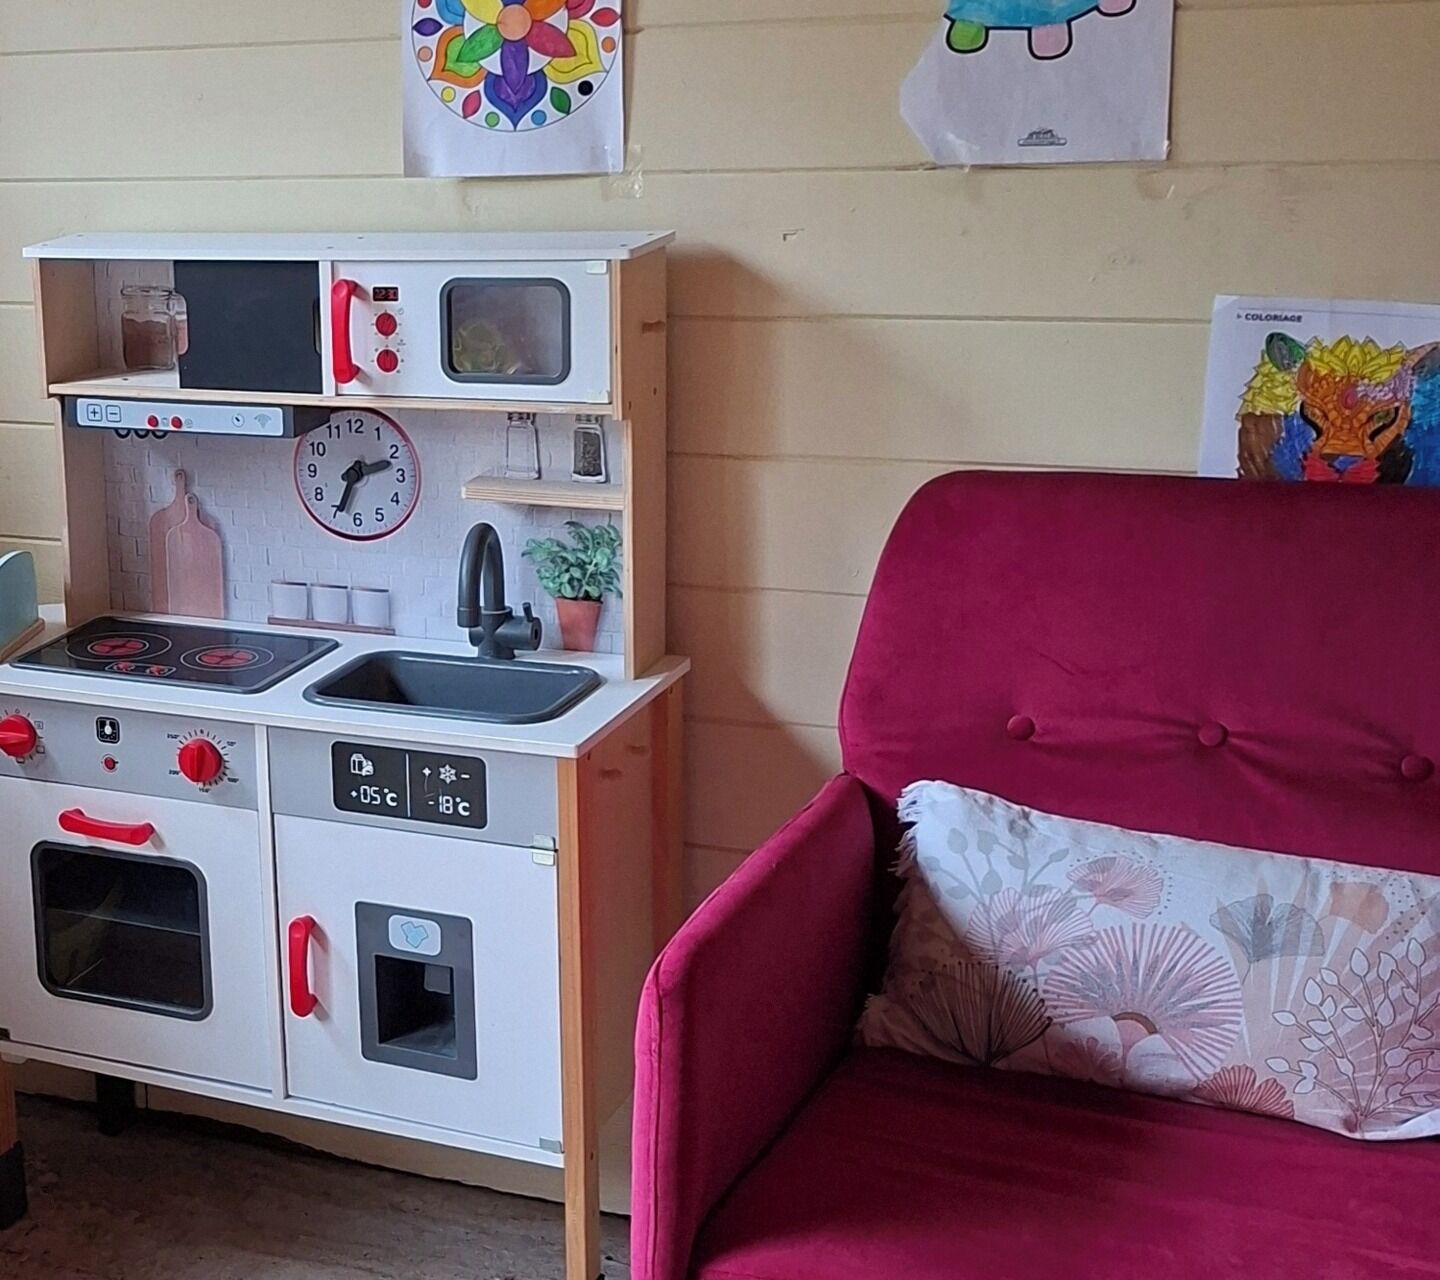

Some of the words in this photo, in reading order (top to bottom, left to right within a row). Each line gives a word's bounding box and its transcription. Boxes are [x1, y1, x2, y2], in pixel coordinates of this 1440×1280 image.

[1245, 312, 1303, 323] COLORIAGE
[326, 423, 341, 439] 11
[346, 418, 364, 434] 12
[374, 426, 381, 441] 1
[309, 441, 326, 457] 10
[389, 444, 400, 459] 2
[307, 463, 318, 478] 9
[396, 468, 406, 483] 3
[314, 487, 324, 501] 8
[390, 491, 401, 506] 4
[331, 504, 341, 519] 7
[374, 507, 385, 522] 5
[352, 512, 363, 527] 6
